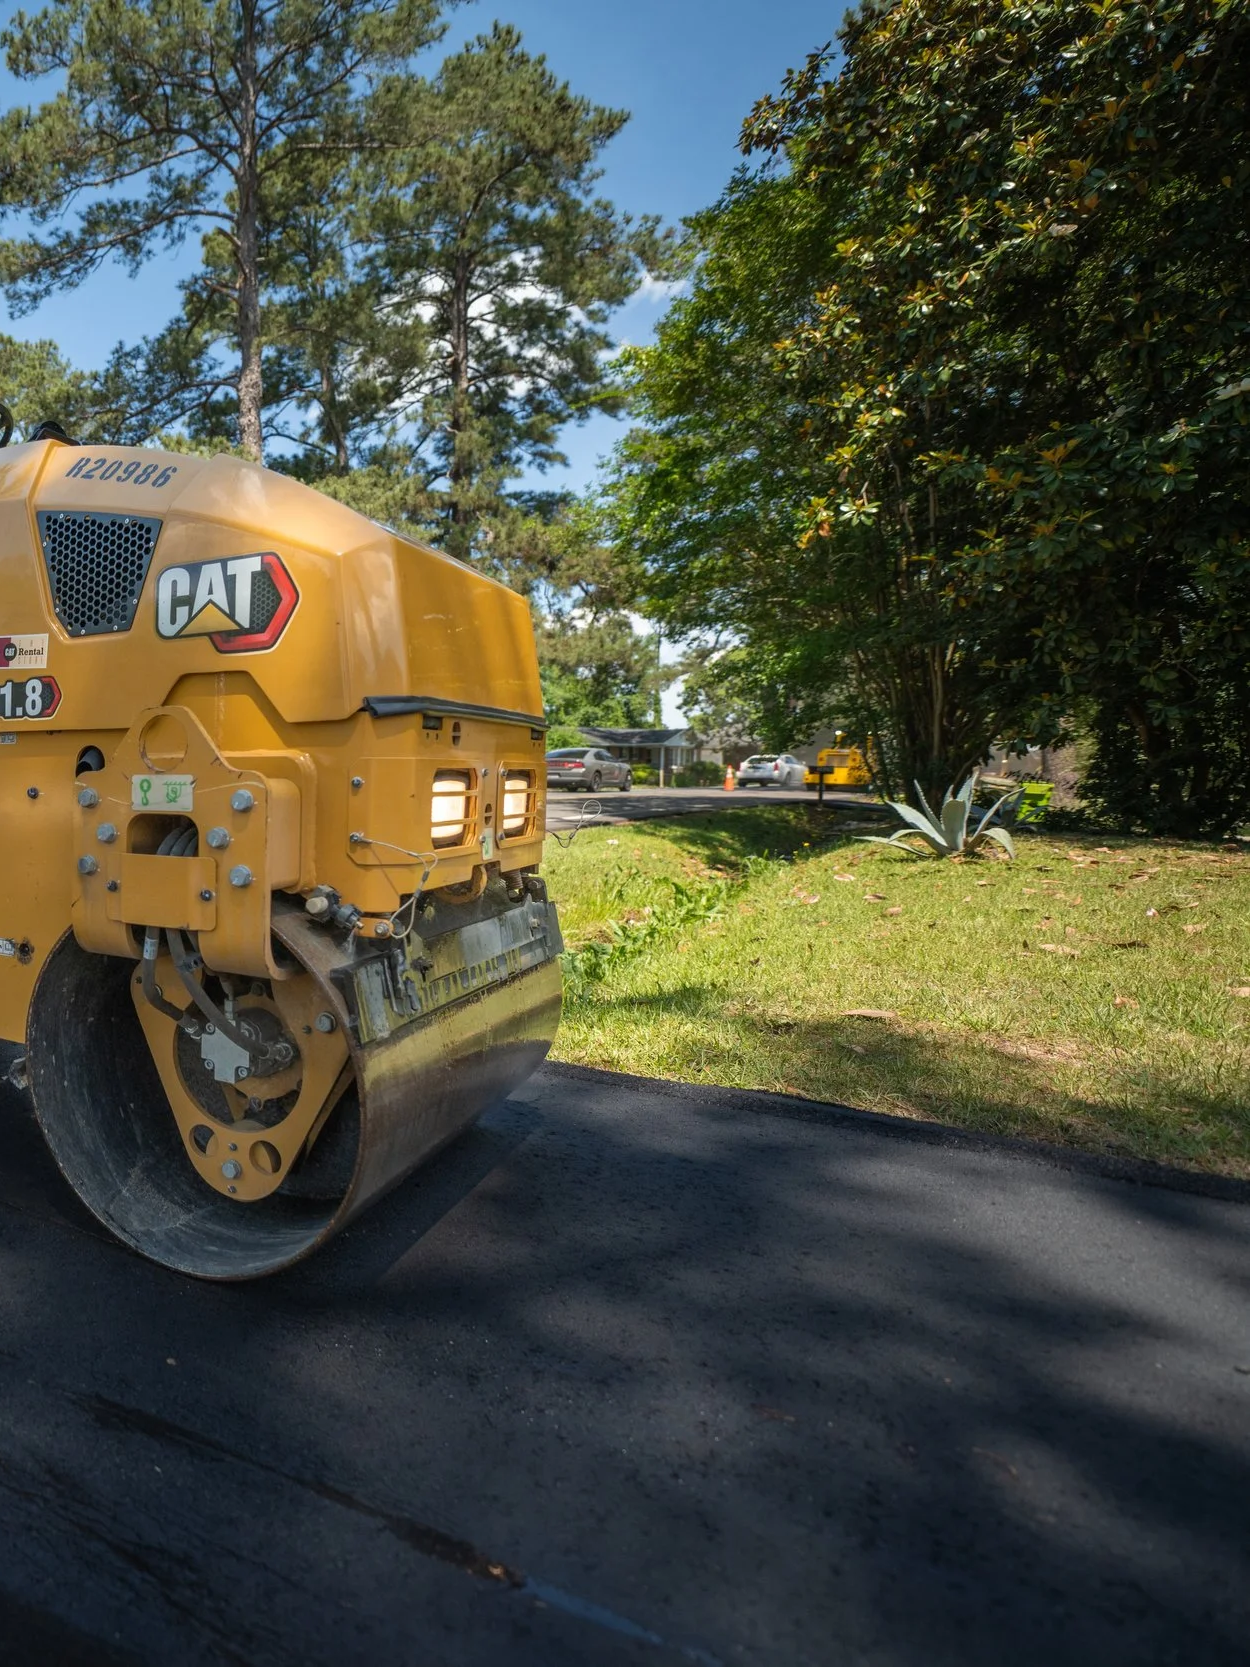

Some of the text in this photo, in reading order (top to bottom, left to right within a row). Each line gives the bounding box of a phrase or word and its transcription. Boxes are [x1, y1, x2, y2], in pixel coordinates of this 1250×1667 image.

[65, 457, 178, 488] R20986
[158, 556, 262, 637] CAT
[5, 647, 15, 656] CAT
[18, 647, 44, 656] Rental
